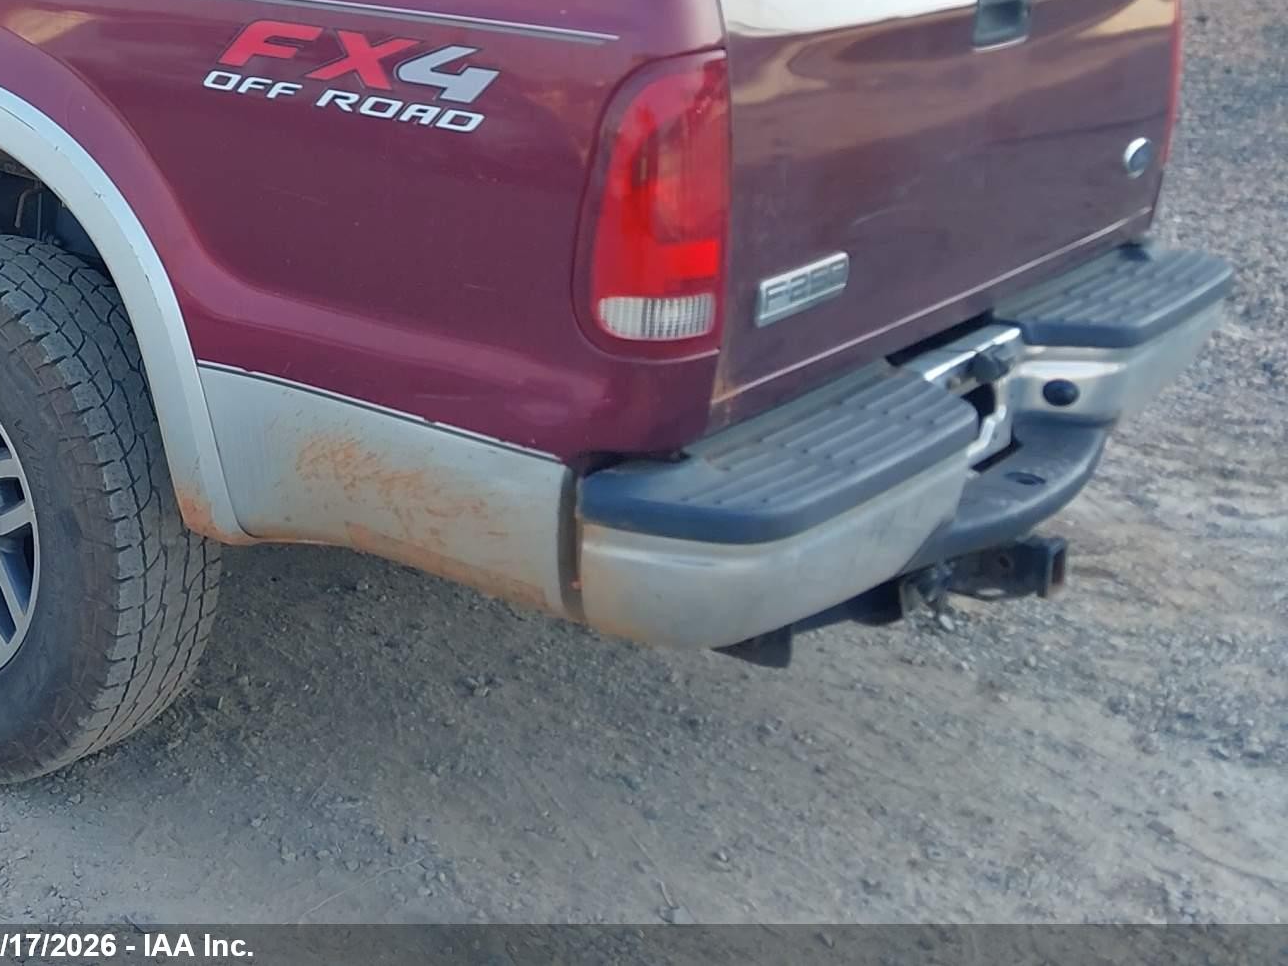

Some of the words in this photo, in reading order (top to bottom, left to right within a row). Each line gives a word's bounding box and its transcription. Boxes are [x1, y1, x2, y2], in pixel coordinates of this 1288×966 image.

[217, 19, 500, 104] FX4
[203, 70, 303, 99] OFF
[315, 89, 485, 133] ROAD
